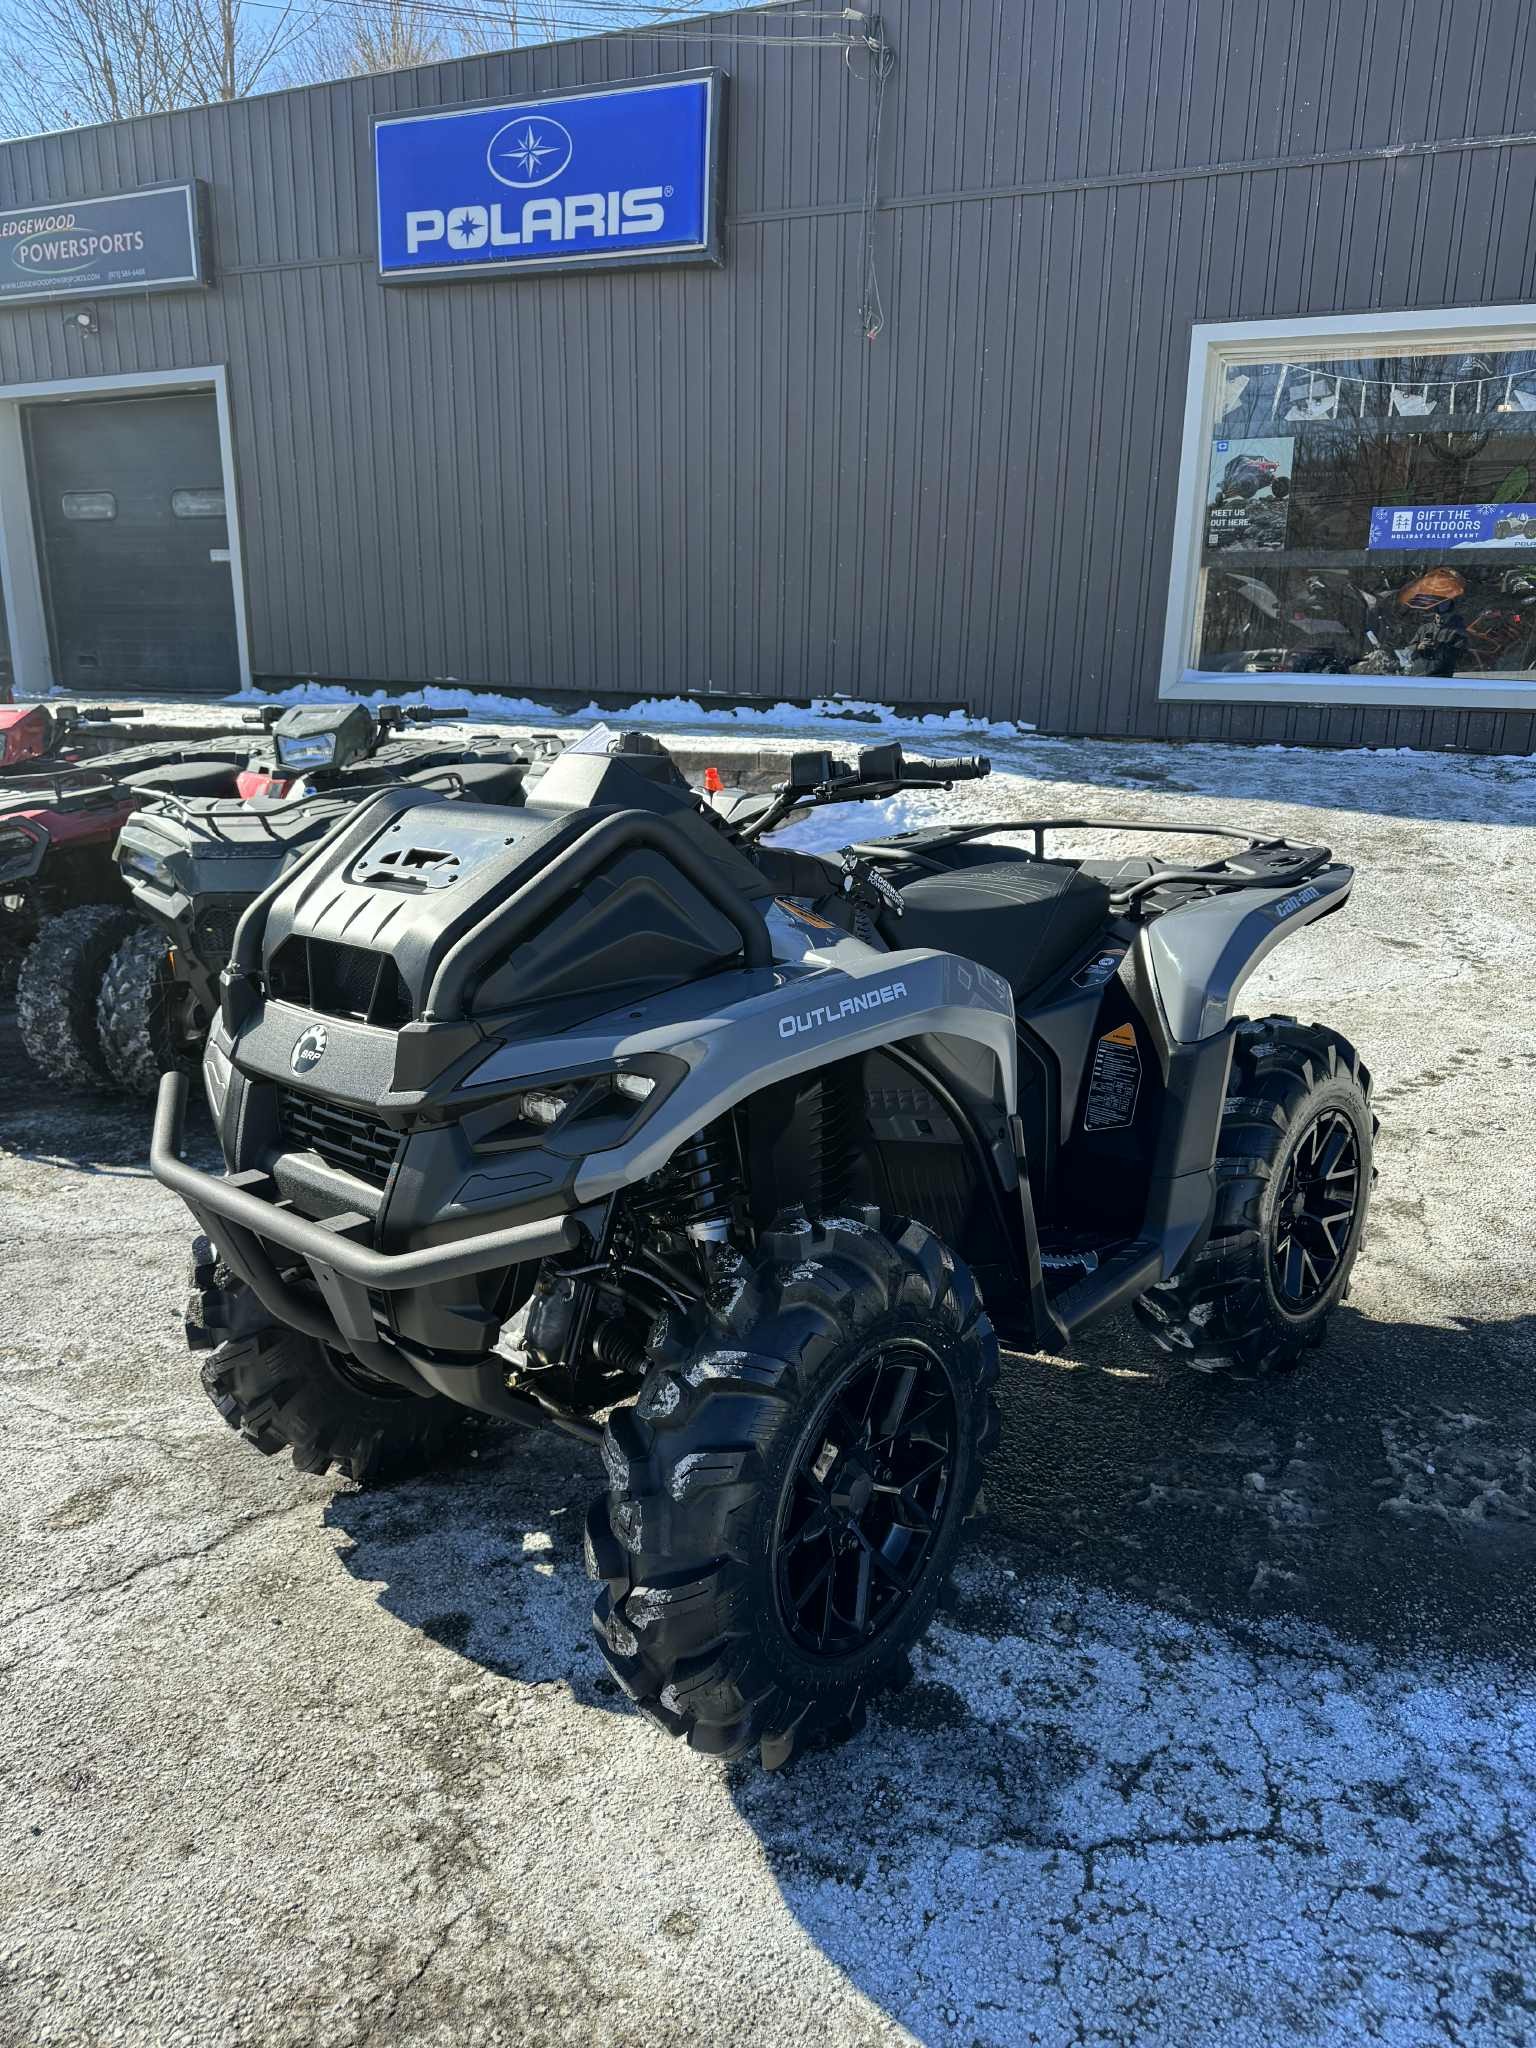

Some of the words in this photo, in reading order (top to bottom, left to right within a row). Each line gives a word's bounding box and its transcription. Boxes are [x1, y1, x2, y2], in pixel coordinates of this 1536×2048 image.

[0, 214, 75, 237] EDGEWOOD
[406, 186, 665, 254] POLARIS
[20, 230, 144, 263] POWERSPORTS
[1211, 509, 1232, 517] MEET
[1234, 508, 1246, 516] US
[1417, 511, 1444, 521] GIFT
[1448, 510, 1472, 520] THE
[1210, 518, 1226, 527] OUT
[1228, 518, 1251, 526] HERE.
[1416, 520, 1481, 531] OUTDOORS
[778, 982, 908, 1038] OUTLANDER
[300, 1049, 321, 1060] BRP
